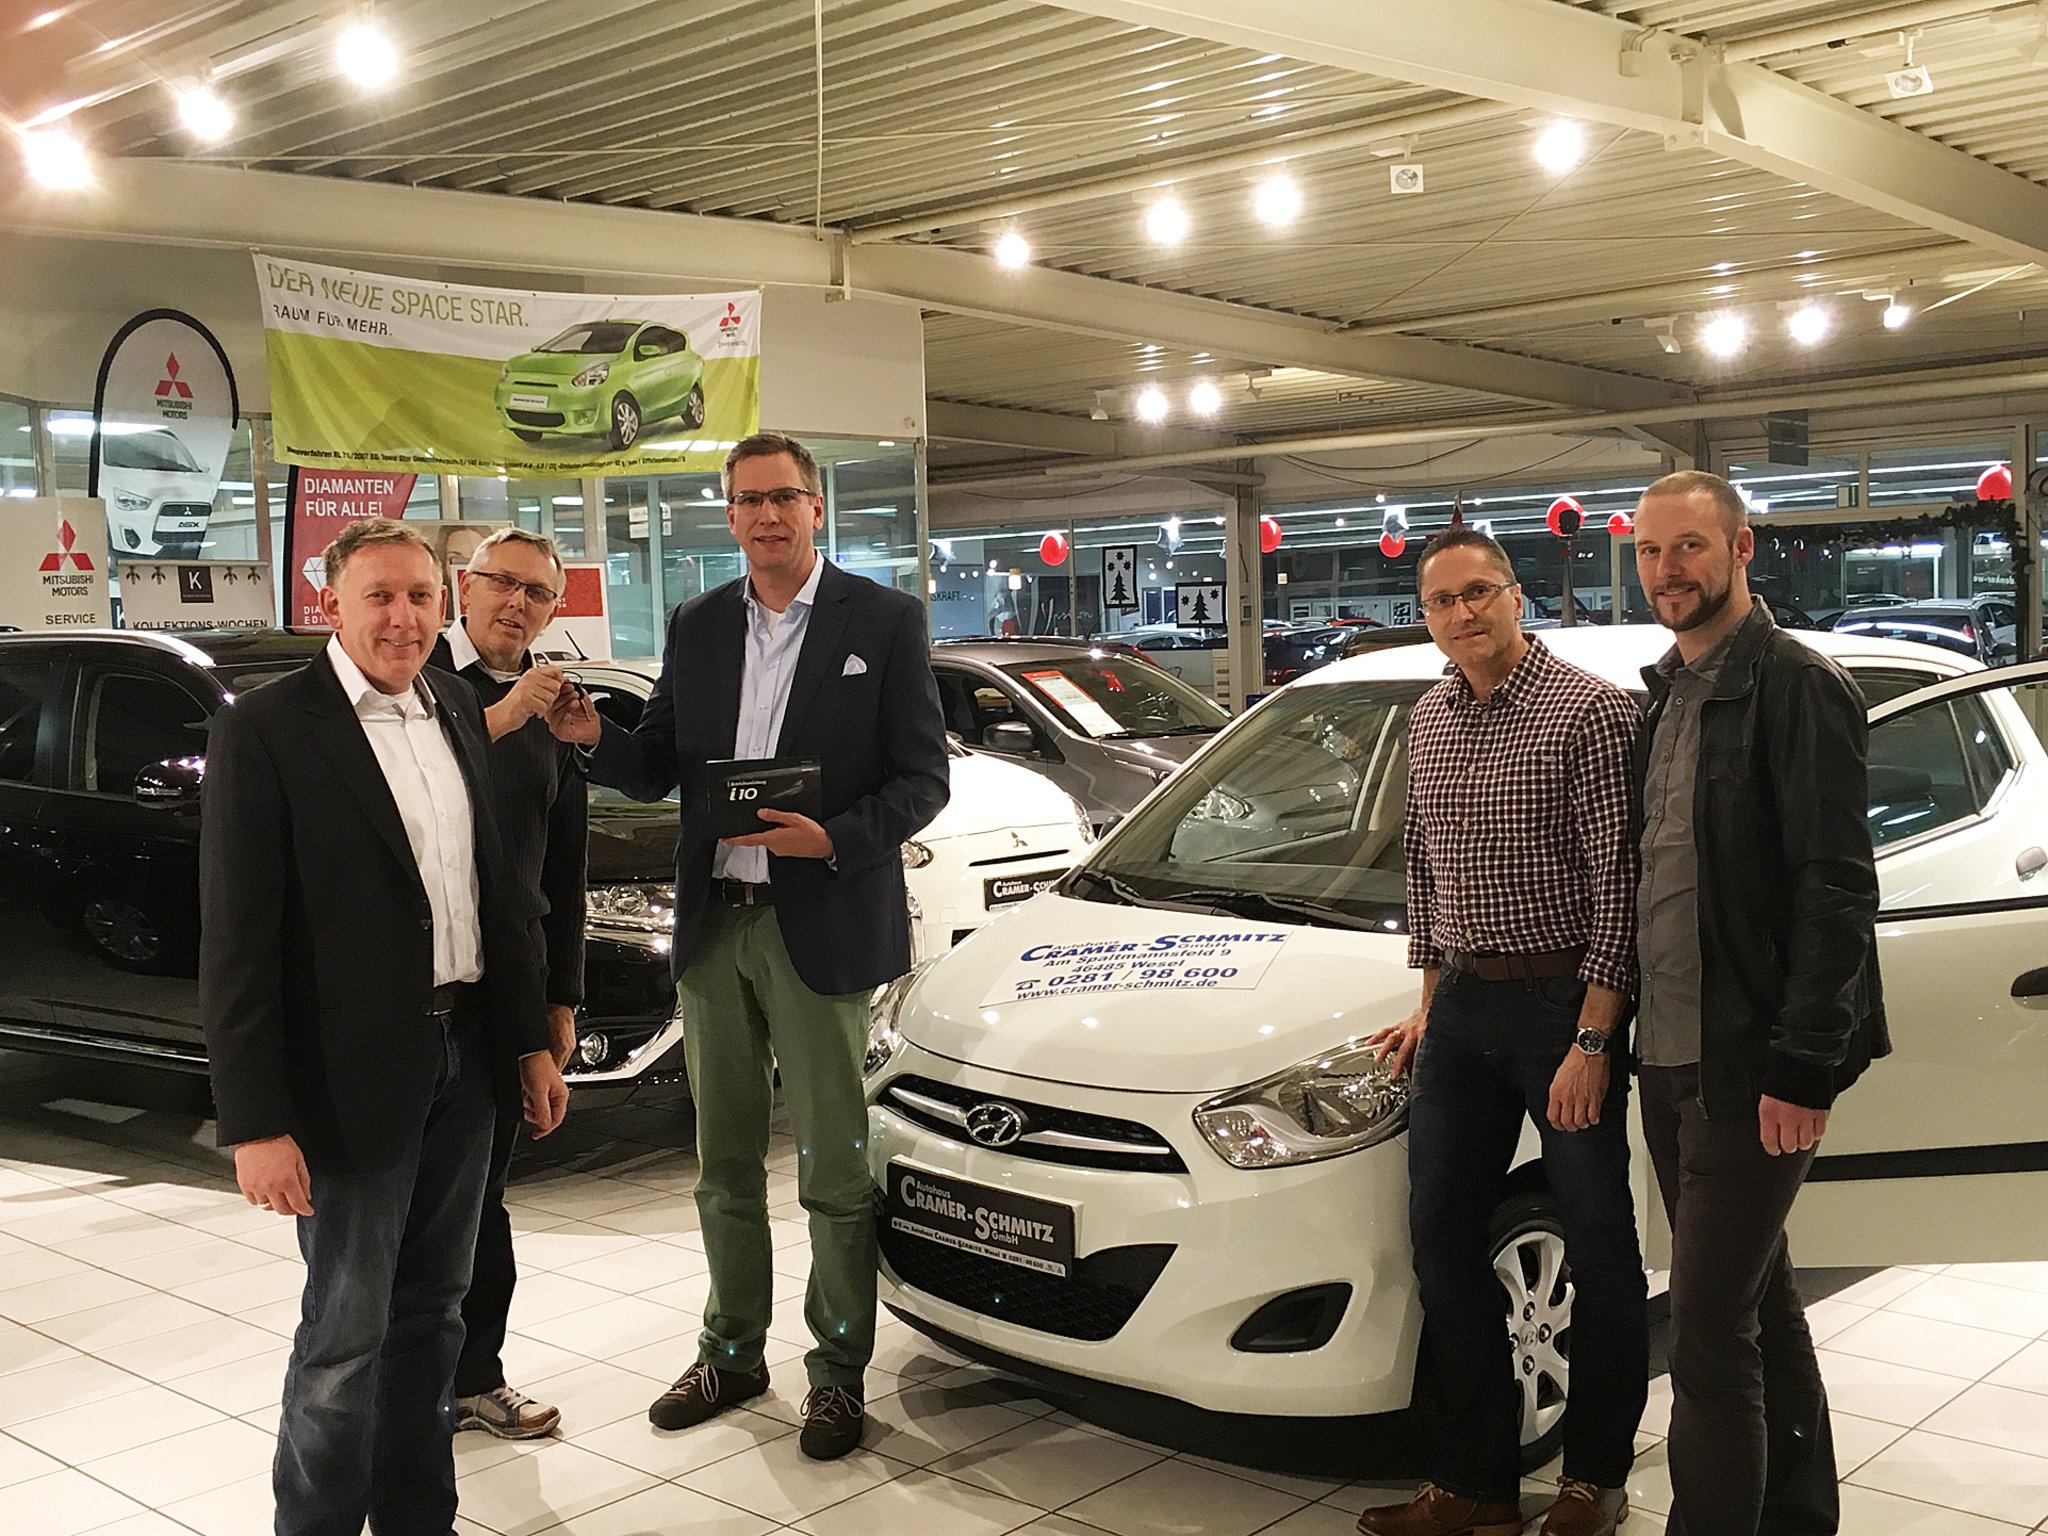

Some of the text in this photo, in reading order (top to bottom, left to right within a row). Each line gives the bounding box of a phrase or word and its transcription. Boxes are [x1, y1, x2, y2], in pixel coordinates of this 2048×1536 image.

[267, 263, 529, 327] DER NEUE SPACE STAR.
[273, 304, 310, 322] RAUM
[346, 317, 393, 336] MEHR.
[156, 399, 193, 410] MITSUBISHI
[162, 410, 188, 420] MOTORS
[304, 478, 394, 495] DIAMANTEN
[305, 499, 383, 517] FÜR ALLE!
[43, 575, 94, 585] MITSUBISHI
[189, 571, 202, 590] K
[52, 587, 89, 597] MOTORS
[45, 613, 97, 625] SERVICE
[1020, 933, 1288, 962] CRAMER-SCHMITZ
[1052, 940, 1120, 951] Autohaus
[1043, 948, 1232, 968] Am Spaltmannsfeld 9
[1071, 959, 1186, 973] 46485 Wesel
[1047, 971, 1114, 987] 0281
[1139, 968, 1175, 980] 98
[1183, 967, 1239, 978] 600
[1017, 978, 1218, 1000] www.cramer-schmitz.de
[916, 1180, 951, 1198] Autohaus
[901, 1175, 1054, 1243] CRAMER-SCHMITZ
[991, 1230, 1019, 1245] GmbH
